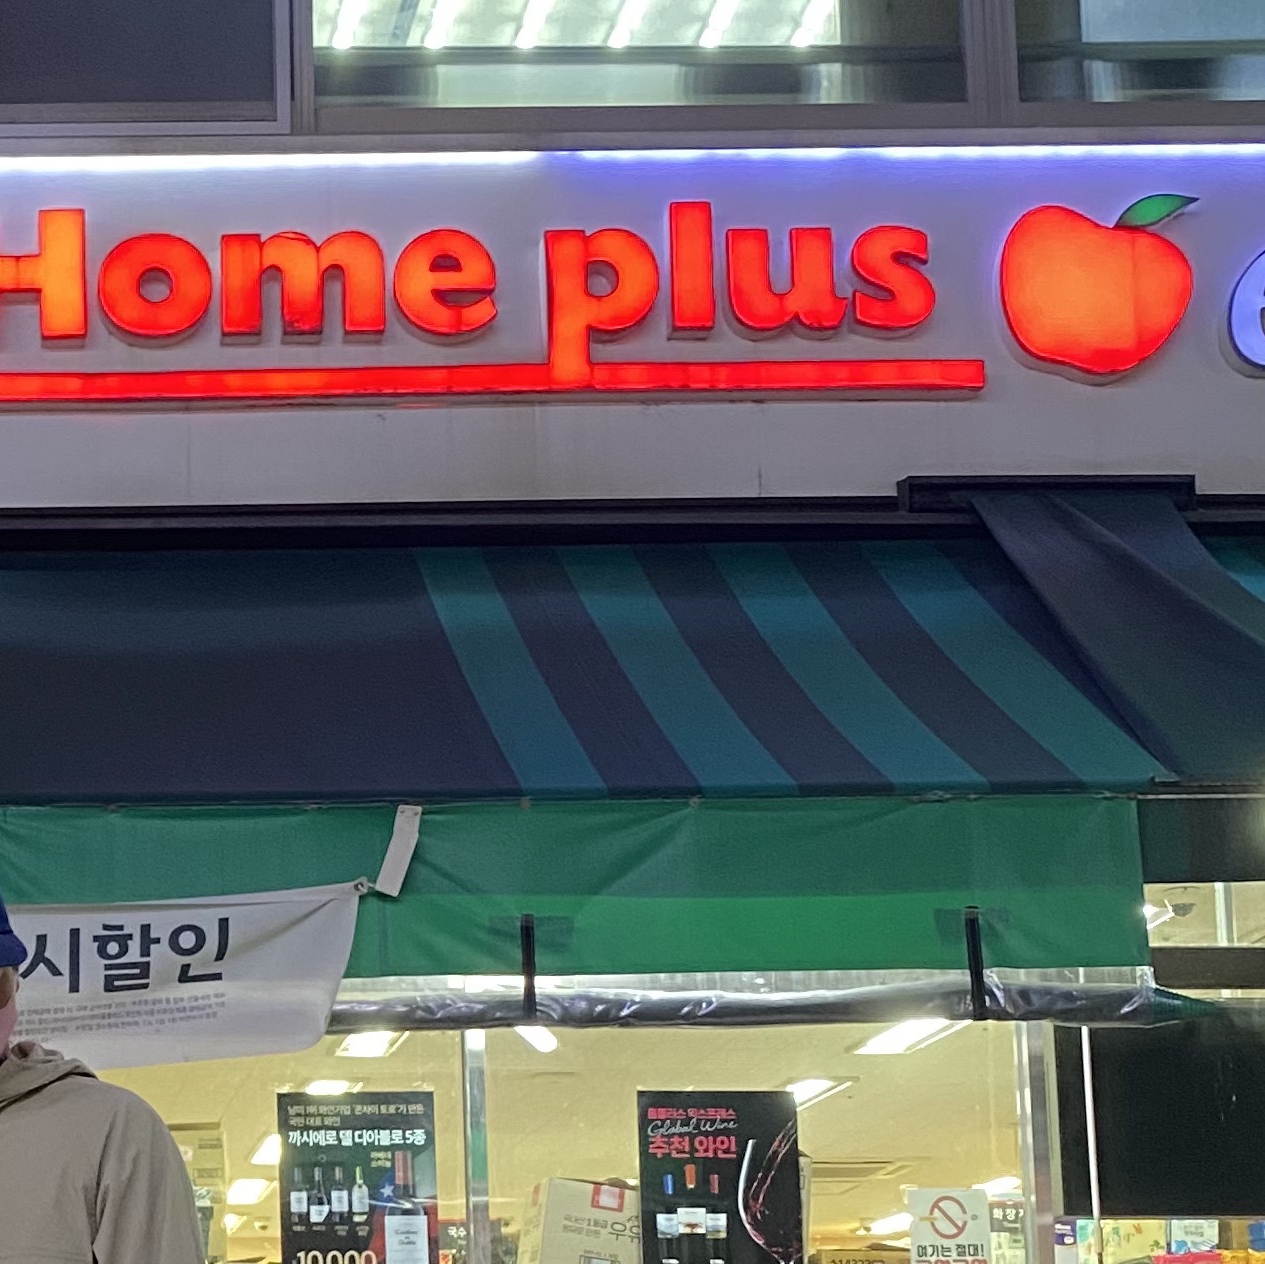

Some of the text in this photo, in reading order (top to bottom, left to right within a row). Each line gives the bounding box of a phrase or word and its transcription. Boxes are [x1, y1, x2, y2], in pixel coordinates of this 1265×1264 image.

[547, 200, 937, 389] plus
[405, 1129, 427, 1145] 5종
[648, 1136, 737, 1158] 추천 와인
[917, 1244, 985, 1258] 여기는 절대!
